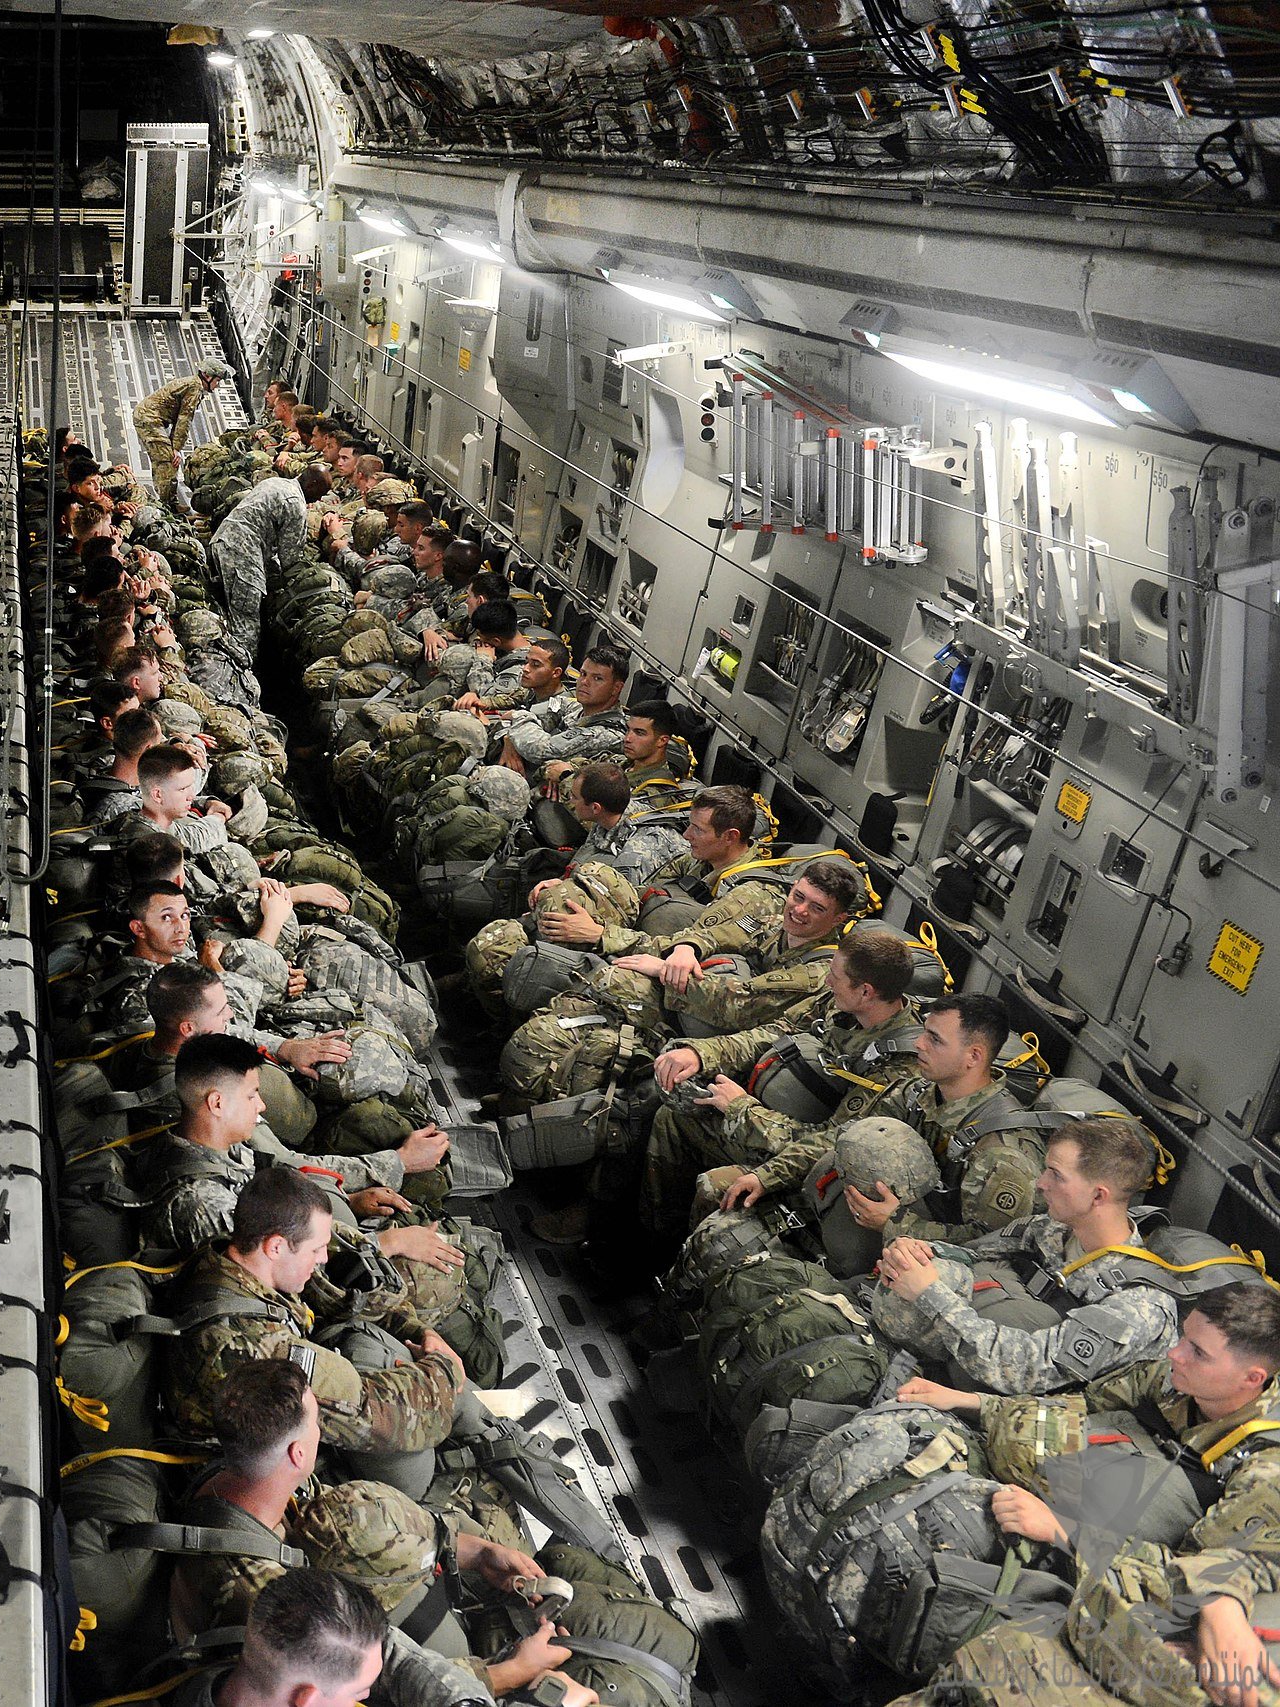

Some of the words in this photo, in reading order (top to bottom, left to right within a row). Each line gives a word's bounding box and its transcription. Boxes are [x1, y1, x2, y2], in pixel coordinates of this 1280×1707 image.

[1105, 455, 1119, 474] 560
[1152, 470, 1168, 489] 550
[1228, 931, 1240, 944] CUT
[1238, 936, 1253, 954] HERE
[1230, 946, 1242, 958] FOR
[1217, 950, 1248, 975] EMERGENCY
[1222, 965, 1235, 979] EXIT
